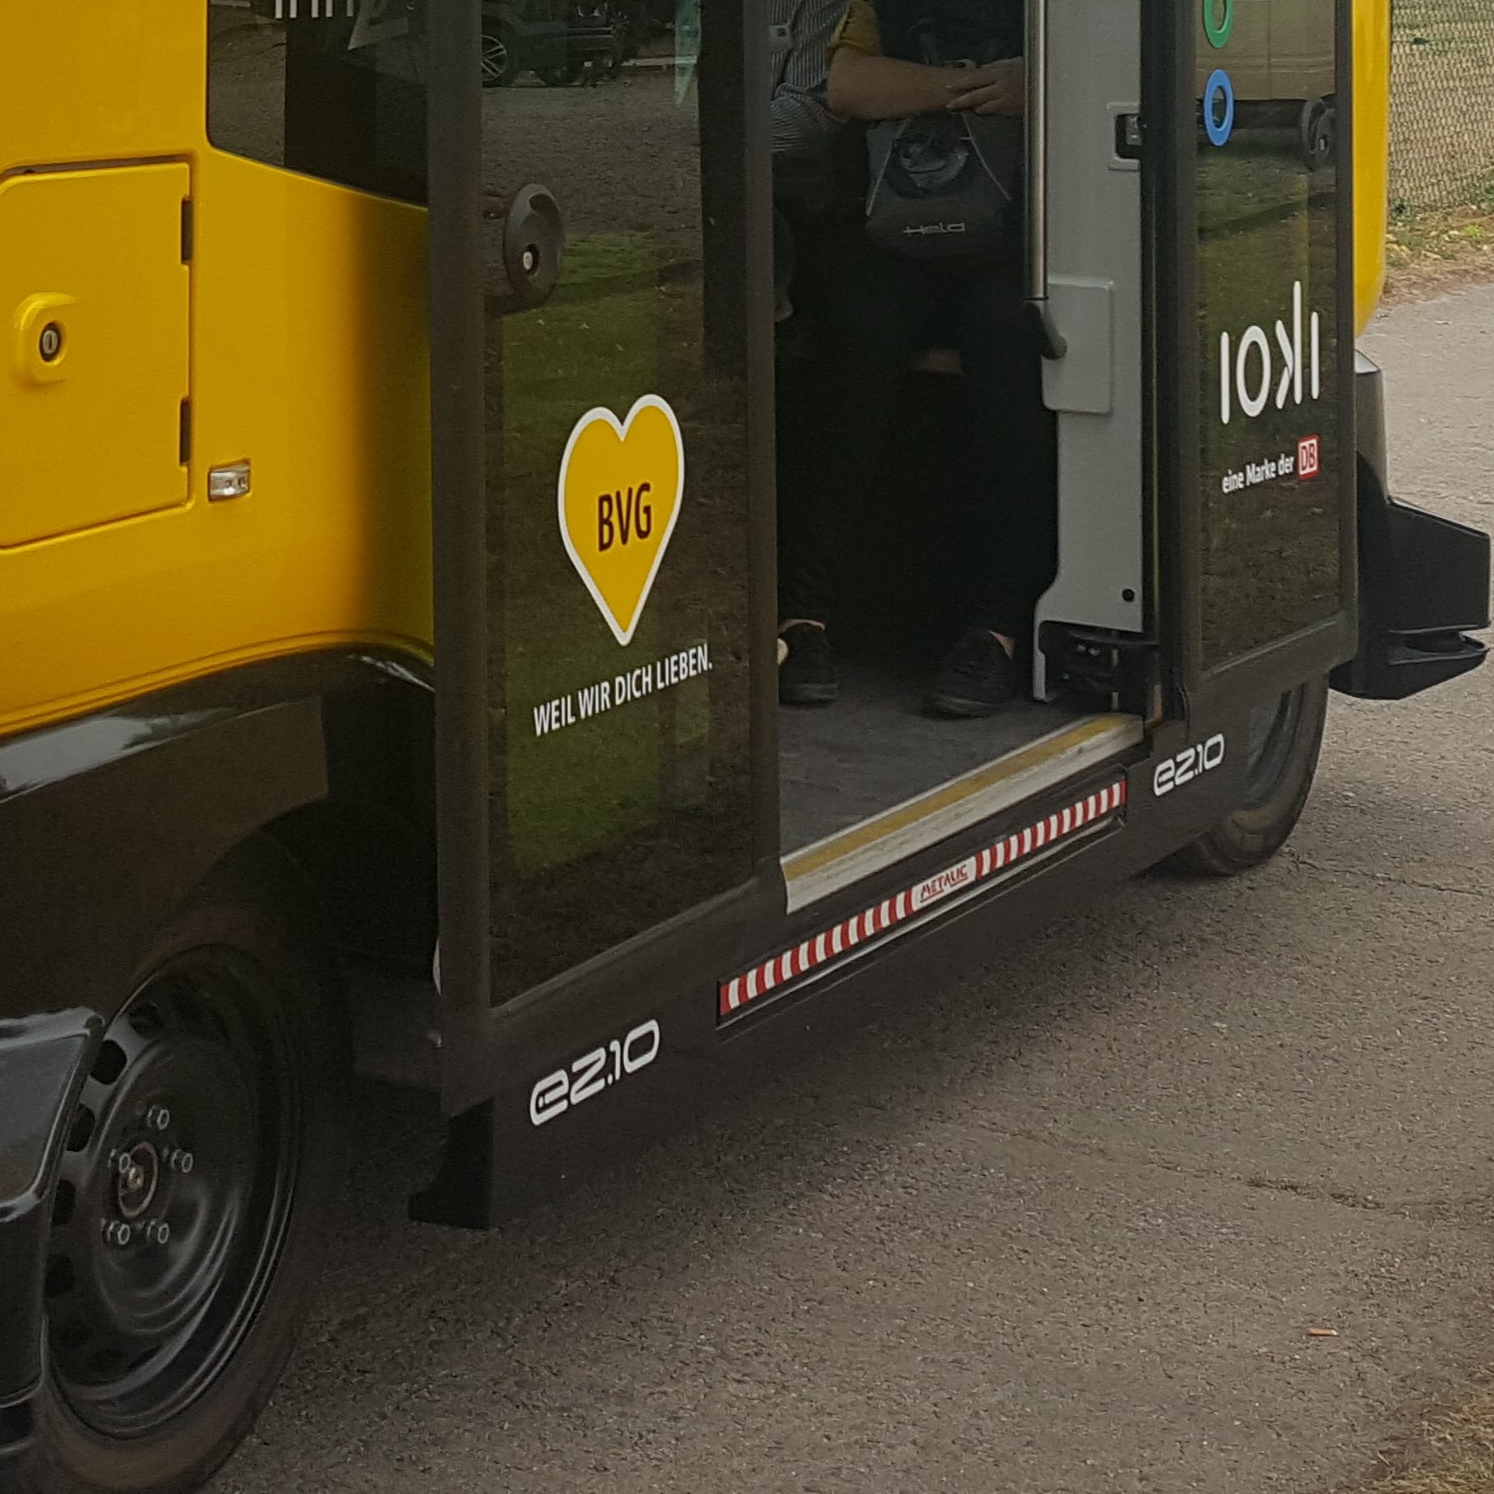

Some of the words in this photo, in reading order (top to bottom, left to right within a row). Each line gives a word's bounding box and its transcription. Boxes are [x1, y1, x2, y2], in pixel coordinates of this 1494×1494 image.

[1222, 469, 1244, 494] eine
[1245, 457, 1277, 486] Marke
[1277, 453, 1295, 475] der
[1298, 440, 1318, 474] DB
[597, 481, 653, 552] BVG
[533, 693, 576, 737] WEIL
[578, 680, 611, 720] WIR
[614, 663, 653, 705] DICH
[656, 643, 713, 691] LIEBEN.
